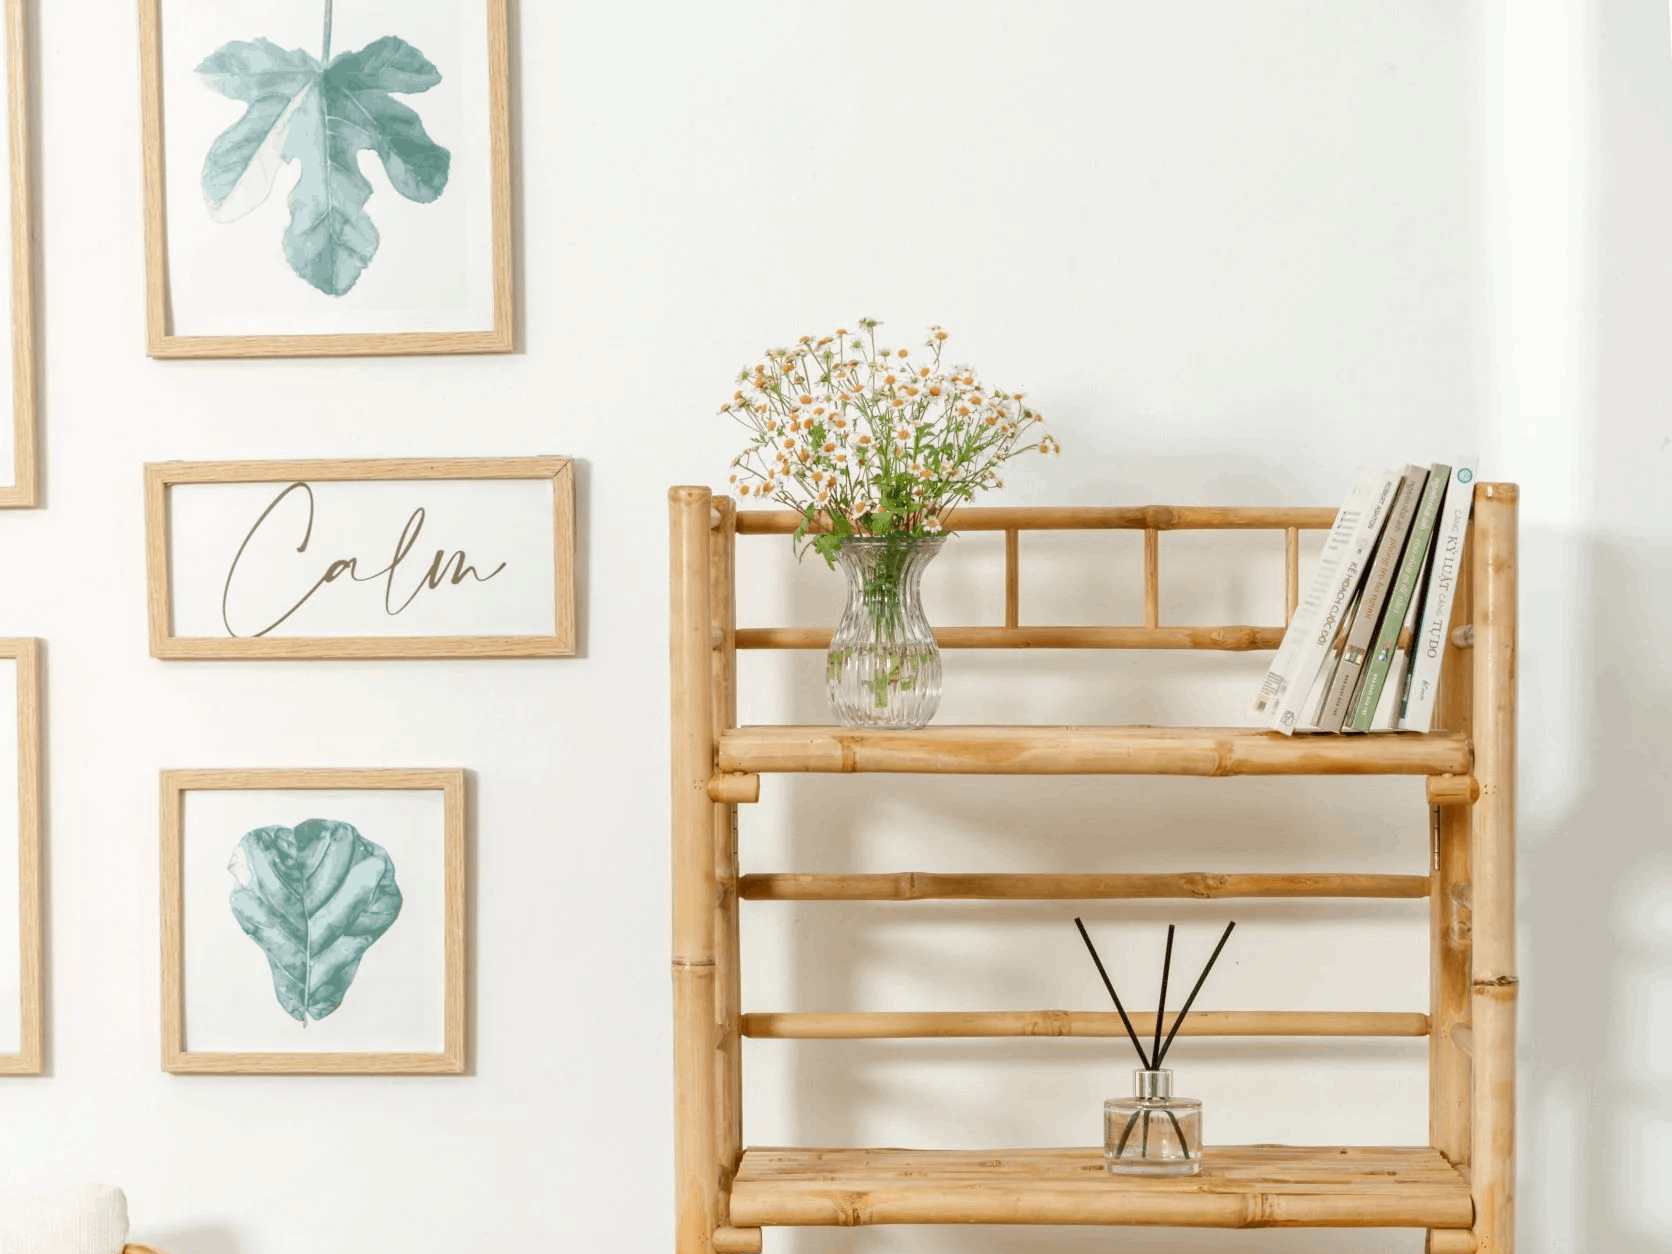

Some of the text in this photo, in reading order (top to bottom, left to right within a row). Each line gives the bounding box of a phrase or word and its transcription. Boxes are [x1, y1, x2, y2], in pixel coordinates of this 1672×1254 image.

[1368, 481, 1393, 529] ROBERT ASHTON
[222, 481, 507, 638] Calm
